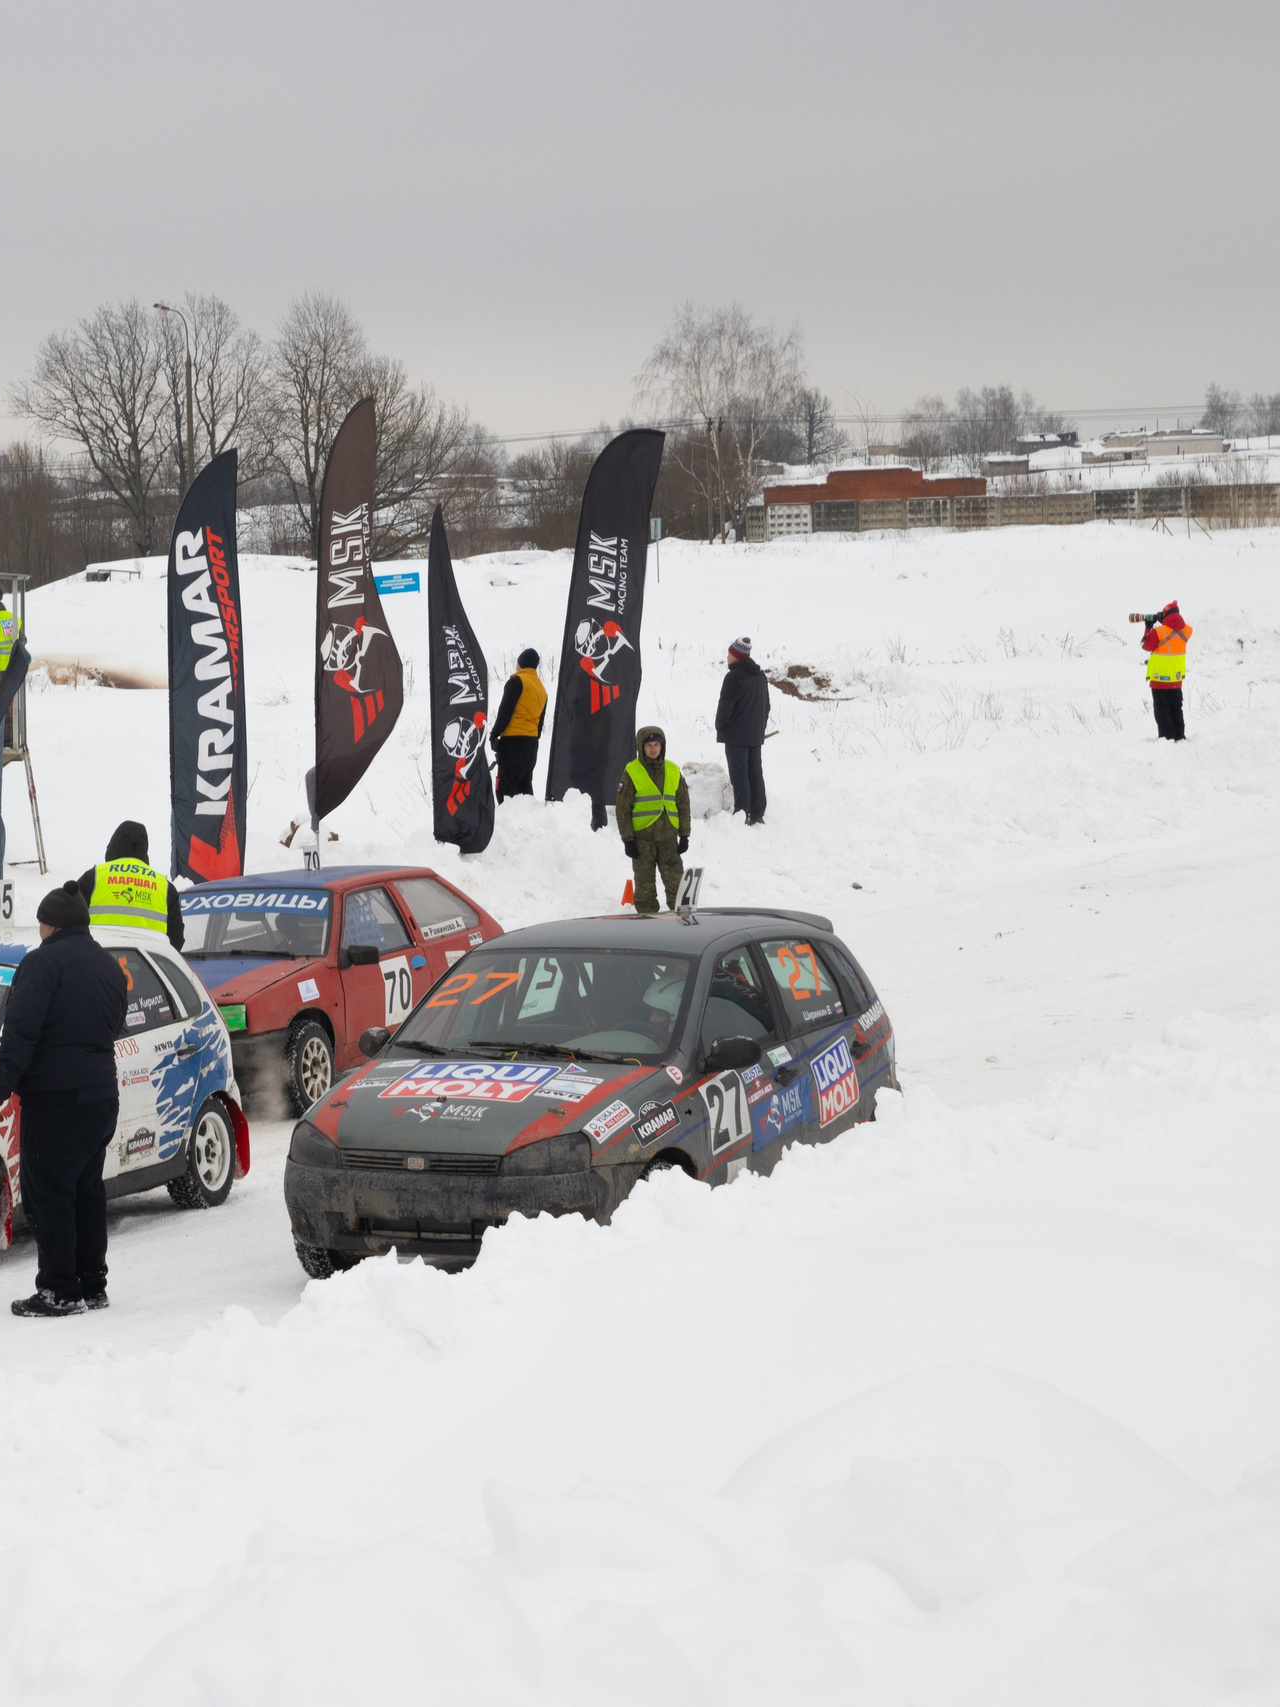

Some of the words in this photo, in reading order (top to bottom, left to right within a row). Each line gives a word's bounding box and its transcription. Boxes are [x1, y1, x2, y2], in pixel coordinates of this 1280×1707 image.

[362, 502, 370, 544] TEAM
[328, 503, 365, 609] MSK
[620, 538, 628, 568] TEAM
[586, 529, 618, 612] MSK
[617, 571, 627, 615] RACING
[175, 527, 235, 815] KRAMAR
[465, 657, 485, 701] RACING
[109, 863, 157, 878] RUSTA
[304, 851, 320, 871] 70
[107, 876, 157, 891] МАРШАЛ
[134, 890, 152, 902] MSK
[681, 868, 703, 905] 27
[180, 893, 328, 911] УХОВИЦЫ
[118, 956, 133, 991] 5
[777, 943, 822, 1001] 27
[383, 967, 411, 1014] 70
[424, 972, 523, 1009] 27
[114, 1038, 140, 1059] РОВ
[154, 1040, 174, 1052] NWB
[410, 1064, 552, 1082] LIQUI
[743, 1065, 762, 1081] RUSTA
[814, 1041, 852, 1091] LIQUI
[388, 1080, 536, 1099] MOLY
[781, 1085, 802, 1116] MSK
[821, 1070, 858, 1122] MOLY
[442, 1104, 489, 1118] MSK
[595, 1108, 613, 1123] YUKA
[612, 1100, 624, 1113] ADV
[637, 1108, 675, 1138] KRAMAR
[705, 1071, 743, 1152] 27
[128, 1136, 153, 1151] KRAMAR
